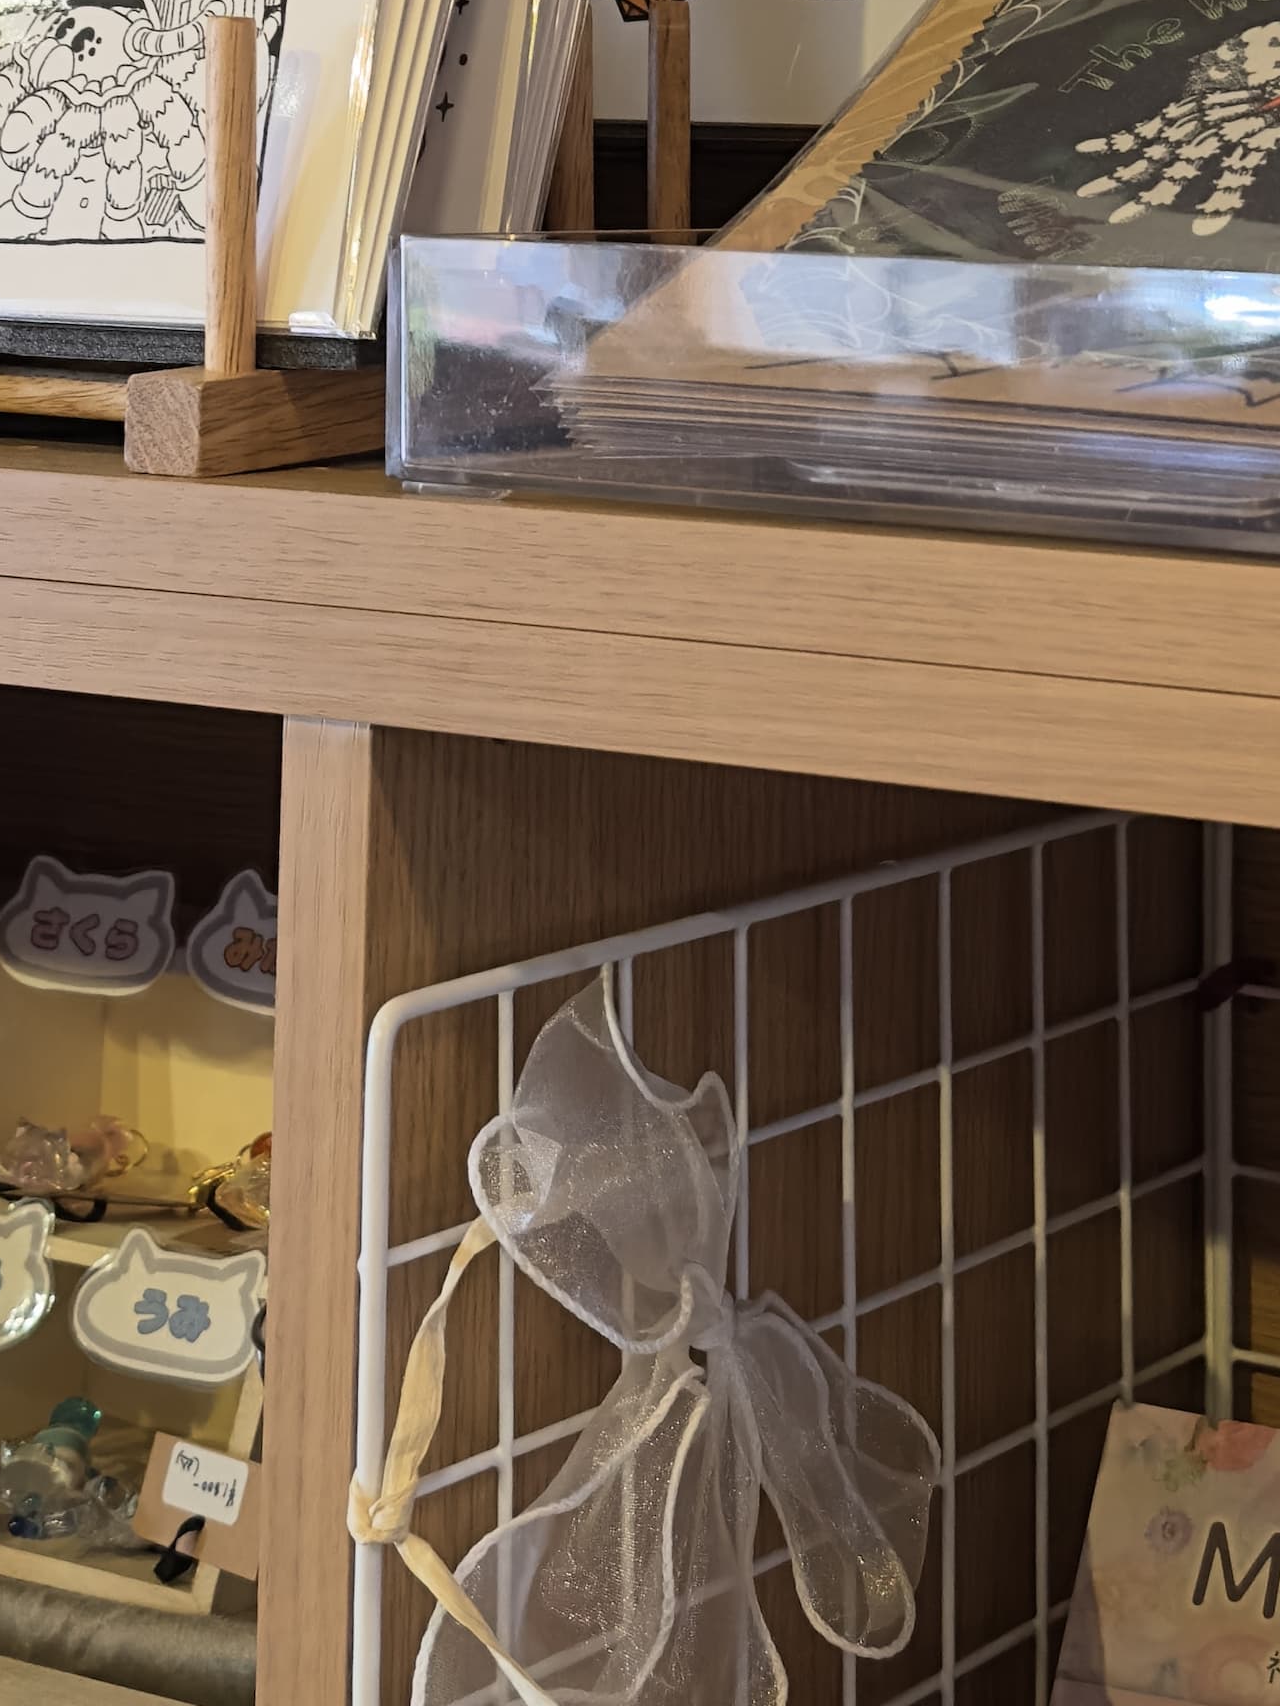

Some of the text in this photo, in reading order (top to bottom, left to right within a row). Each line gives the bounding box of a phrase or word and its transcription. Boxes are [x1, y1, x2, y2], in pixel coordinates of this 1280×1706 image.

[29, 906, 141, 963] さくら
[132, 1288, 213, 1343] うみ
